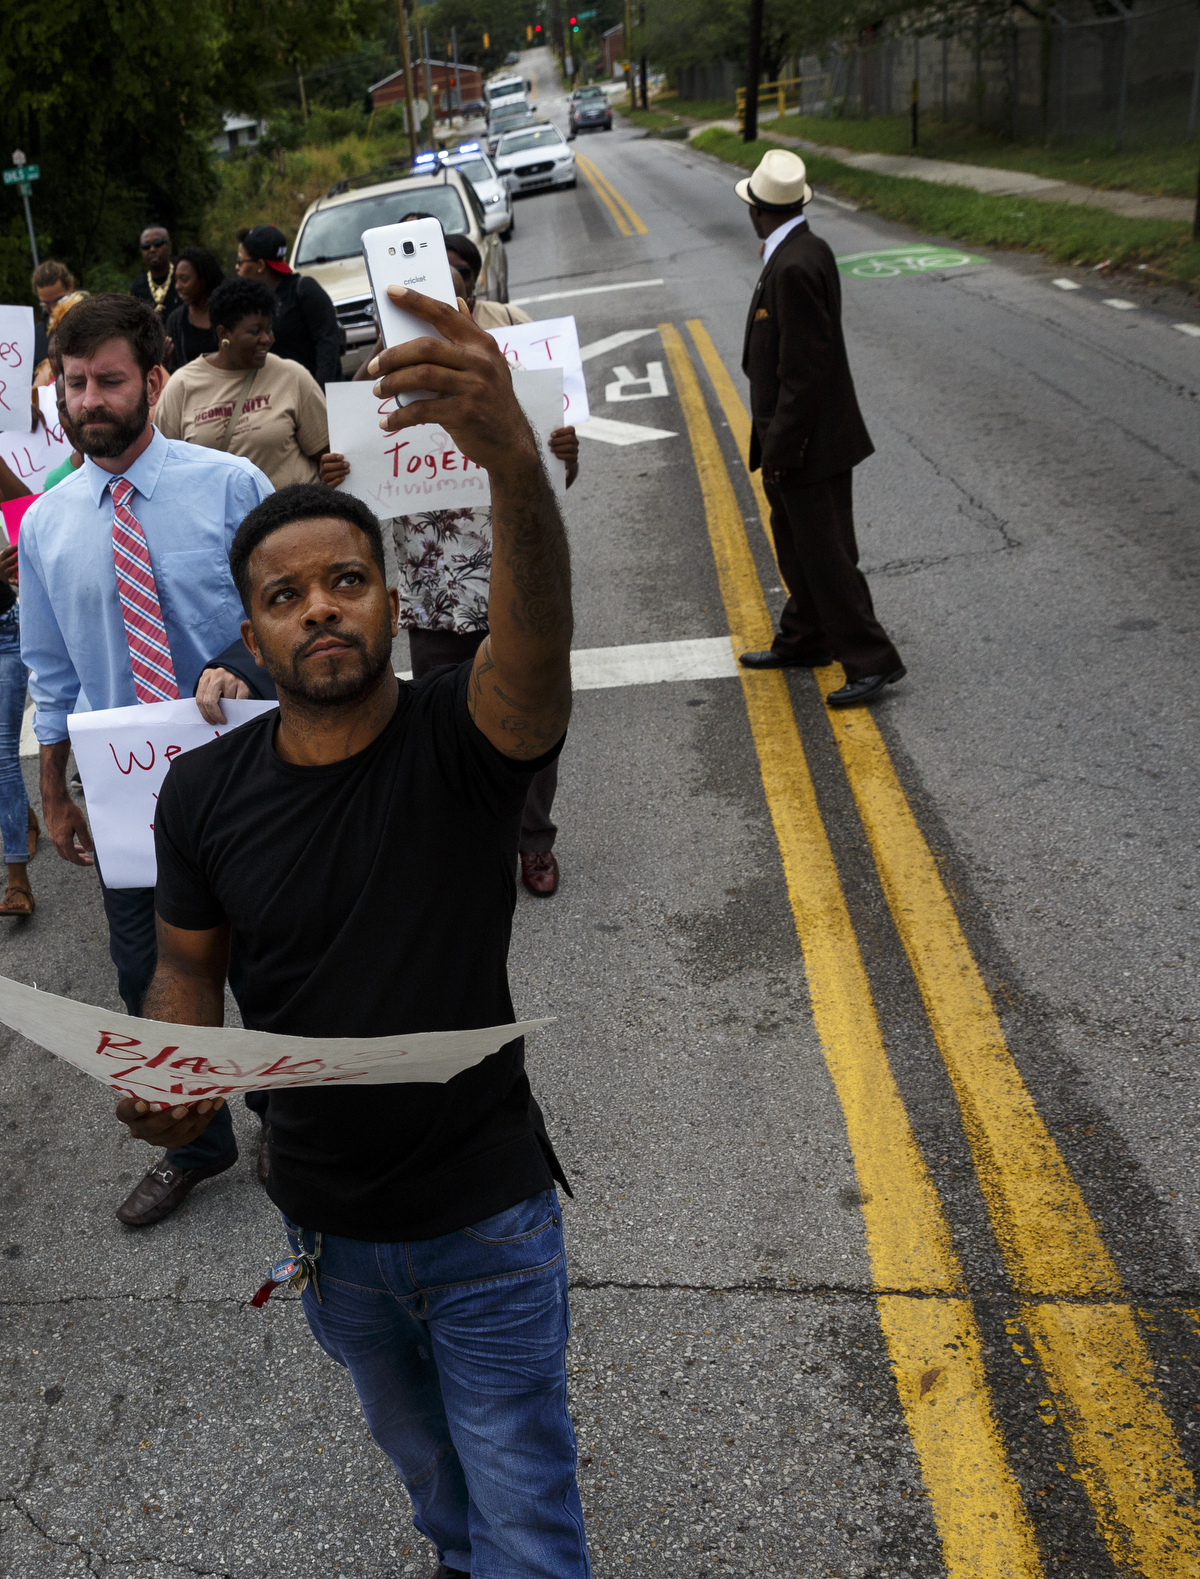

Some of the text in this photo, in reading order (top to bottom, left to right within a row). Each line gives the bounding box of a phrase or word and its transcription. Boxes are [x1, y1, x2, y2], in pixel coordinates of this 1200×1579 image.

[403, 275, 427, 285] cricket
[194, 394, 271, 423] #COMMNITY
[0, 447, 46, 478] LL
